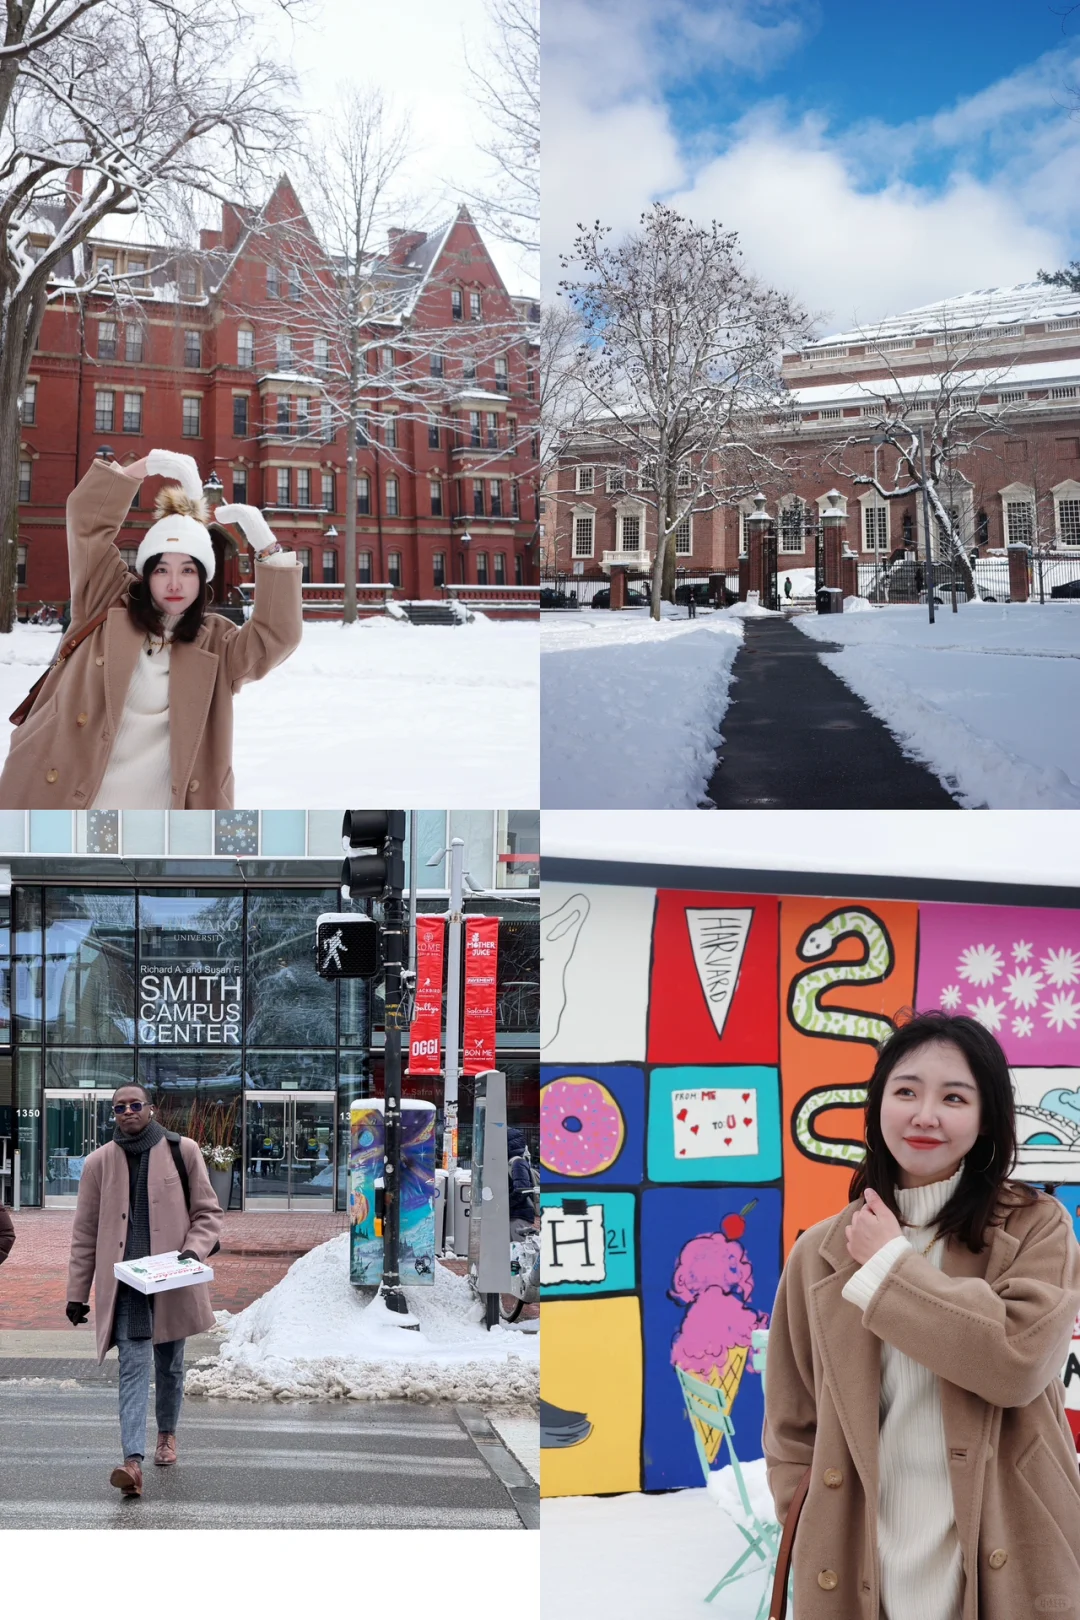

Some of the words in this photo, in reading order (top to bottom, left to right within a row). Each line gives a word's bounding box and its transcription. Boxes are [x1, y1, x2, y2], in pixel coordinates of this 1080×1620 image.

[140, 965, 173, 974] Richard
[175, 966, 184, 974] A.
[186, 965, 202, 974] and
[204, 965, 231, 974] Susan
[234, 966, 241, 974] F.
[697, 917, 742, 1003] HARVARD
[140, 975, 241, 1002] SMITH
[140, 1003, 241, 1022] CAMPUS
[140, 1024, 240, 1043] CENTER
[412, 1038, 439, 1057] OGGI
[464, 1049, 481, 1057] BON
[482, 1049, 493, 1057] ME
[701, 1090, 717, 1101] ME
[16, 1109, 40, 1117] 1350
[726, 1114, 737, 1129] U
[547, 1219, 595, 1267] H
[607, 1228, 626, 1250] 21
